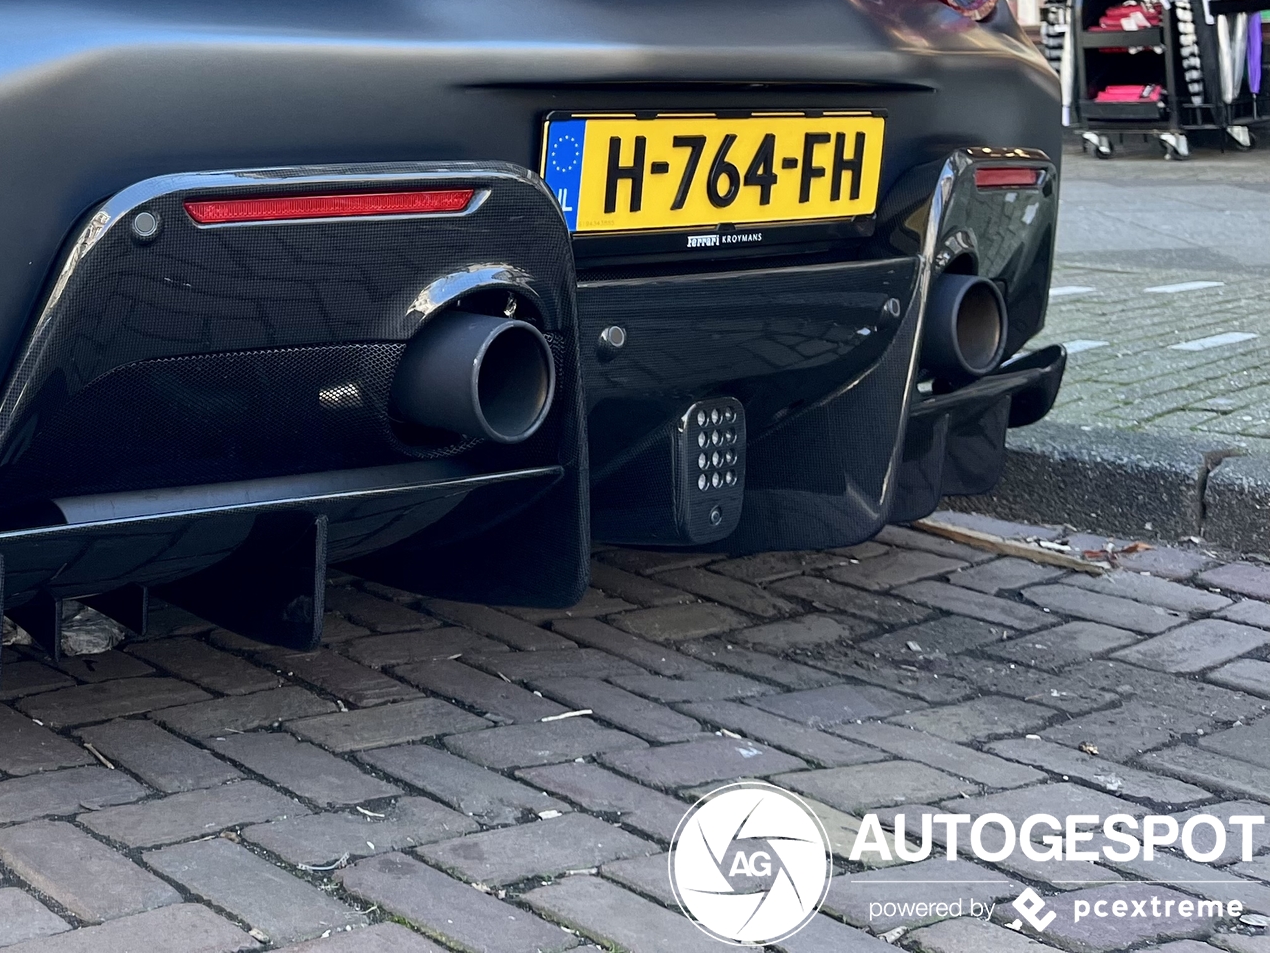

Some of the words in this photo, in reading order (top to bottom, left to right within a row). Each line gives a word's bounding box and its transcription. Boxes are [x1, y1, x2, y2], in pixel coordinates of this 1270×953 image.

[603, 131, 867, 214] H-764-FH
[686, 234, 720, 248] Ferrari
[721, 232, 763, 244] KROYMANS
